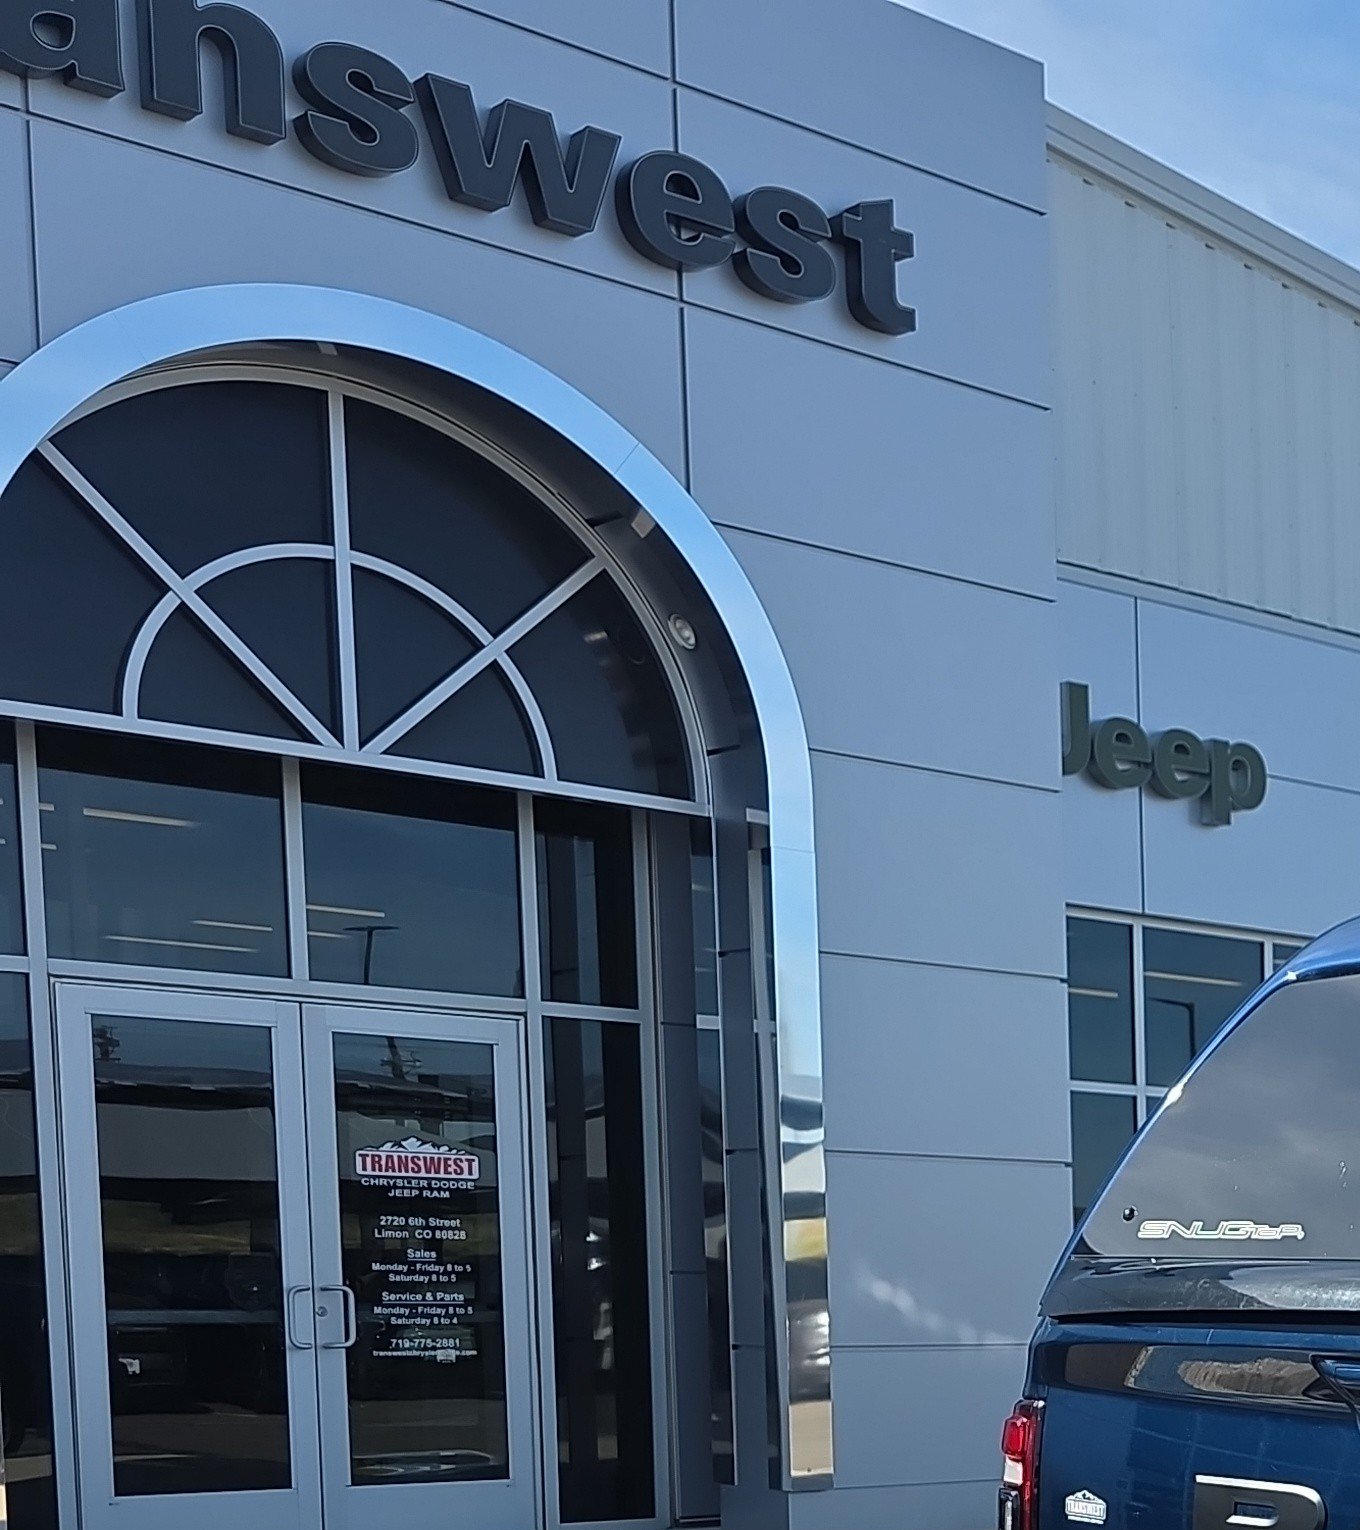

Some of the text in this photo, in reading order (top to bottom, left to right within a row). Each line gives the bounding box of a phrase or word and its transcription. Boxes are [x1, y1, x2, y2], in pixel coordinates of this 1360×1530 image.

[0, 0, 918, 336] answest
[358, 1153, 475, 1176] TRANSWEST
[361, 1178, 475, 1190] CHRYSLER DODGE
[388, 1188, 450, 1198] JEEP RAM
[380, 1216, 461, 1227] 2720 6th Street
[374, 1228, 466, 1240] Limon CO 80828
[407, 1248, 437, 1258] Sales
[372, 1263, 408, 1272] Monday
[416, 1263, 445, 1273] Friday
[388, 1273, 457, 1283] Saturday 8 to 5
[382, 1291, 465, 1301] Service & Parts
[373, 1306, 410, 1316] Monday
[418, 1306, 446, 1316] Friday
[390, 1317, 431, 1326] Saturday
[440, 1317, 450, 1325] to
[452, 1317, 458, 1325] 4
[390, 1338, 460, 1348] 719-775-2881
